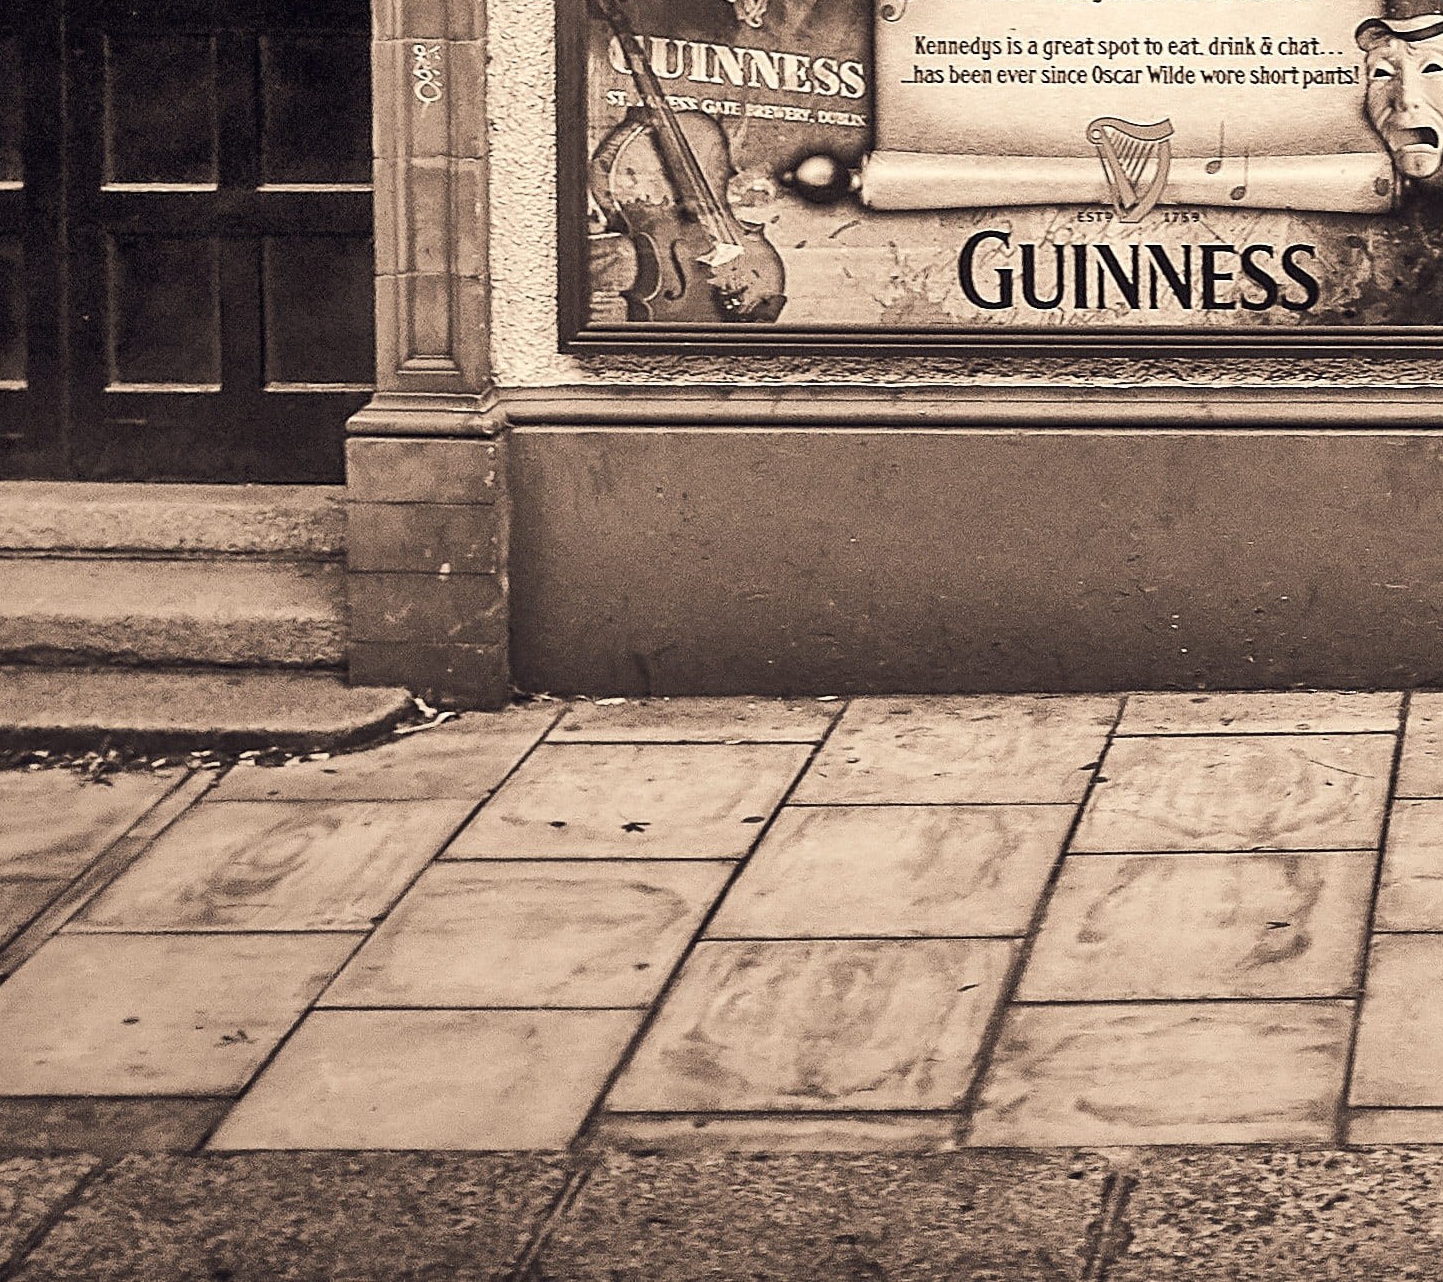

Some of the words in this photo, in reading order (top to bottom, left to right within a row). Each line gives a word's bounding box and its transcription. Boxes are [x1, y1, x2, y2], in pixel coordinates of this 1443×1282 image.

[915, 35, 1002, 61] Kennedys
[1006, 36, 1023, 55] is
[1027, 40, 1038, 55] a
[1043, 37, 1095, 61] great
[1097, 37, 1140, 60] spot
[1143, 37, 1163, 56] to
[1208, 36, 1256, 56] drink
[1259, 36, 1273, 56] &
[948, 64, 992, 84] been
[996, 69, 1037, 84] ever
[1041, 65, 1088, 85] since
[1091, 65, 1143, 85] Oscar
[1145, 65, 1195, 85] Wilde
[1199, 69, 1246, 85] wore
[1249, 65, 1300, 85] short
[1302, 65, 1360, 90] pants!
[701, 100, 741, 116] GATE
[1164, 212, 1200, 223] 1759
[957, 230, 1321, 311] GUINNESS
